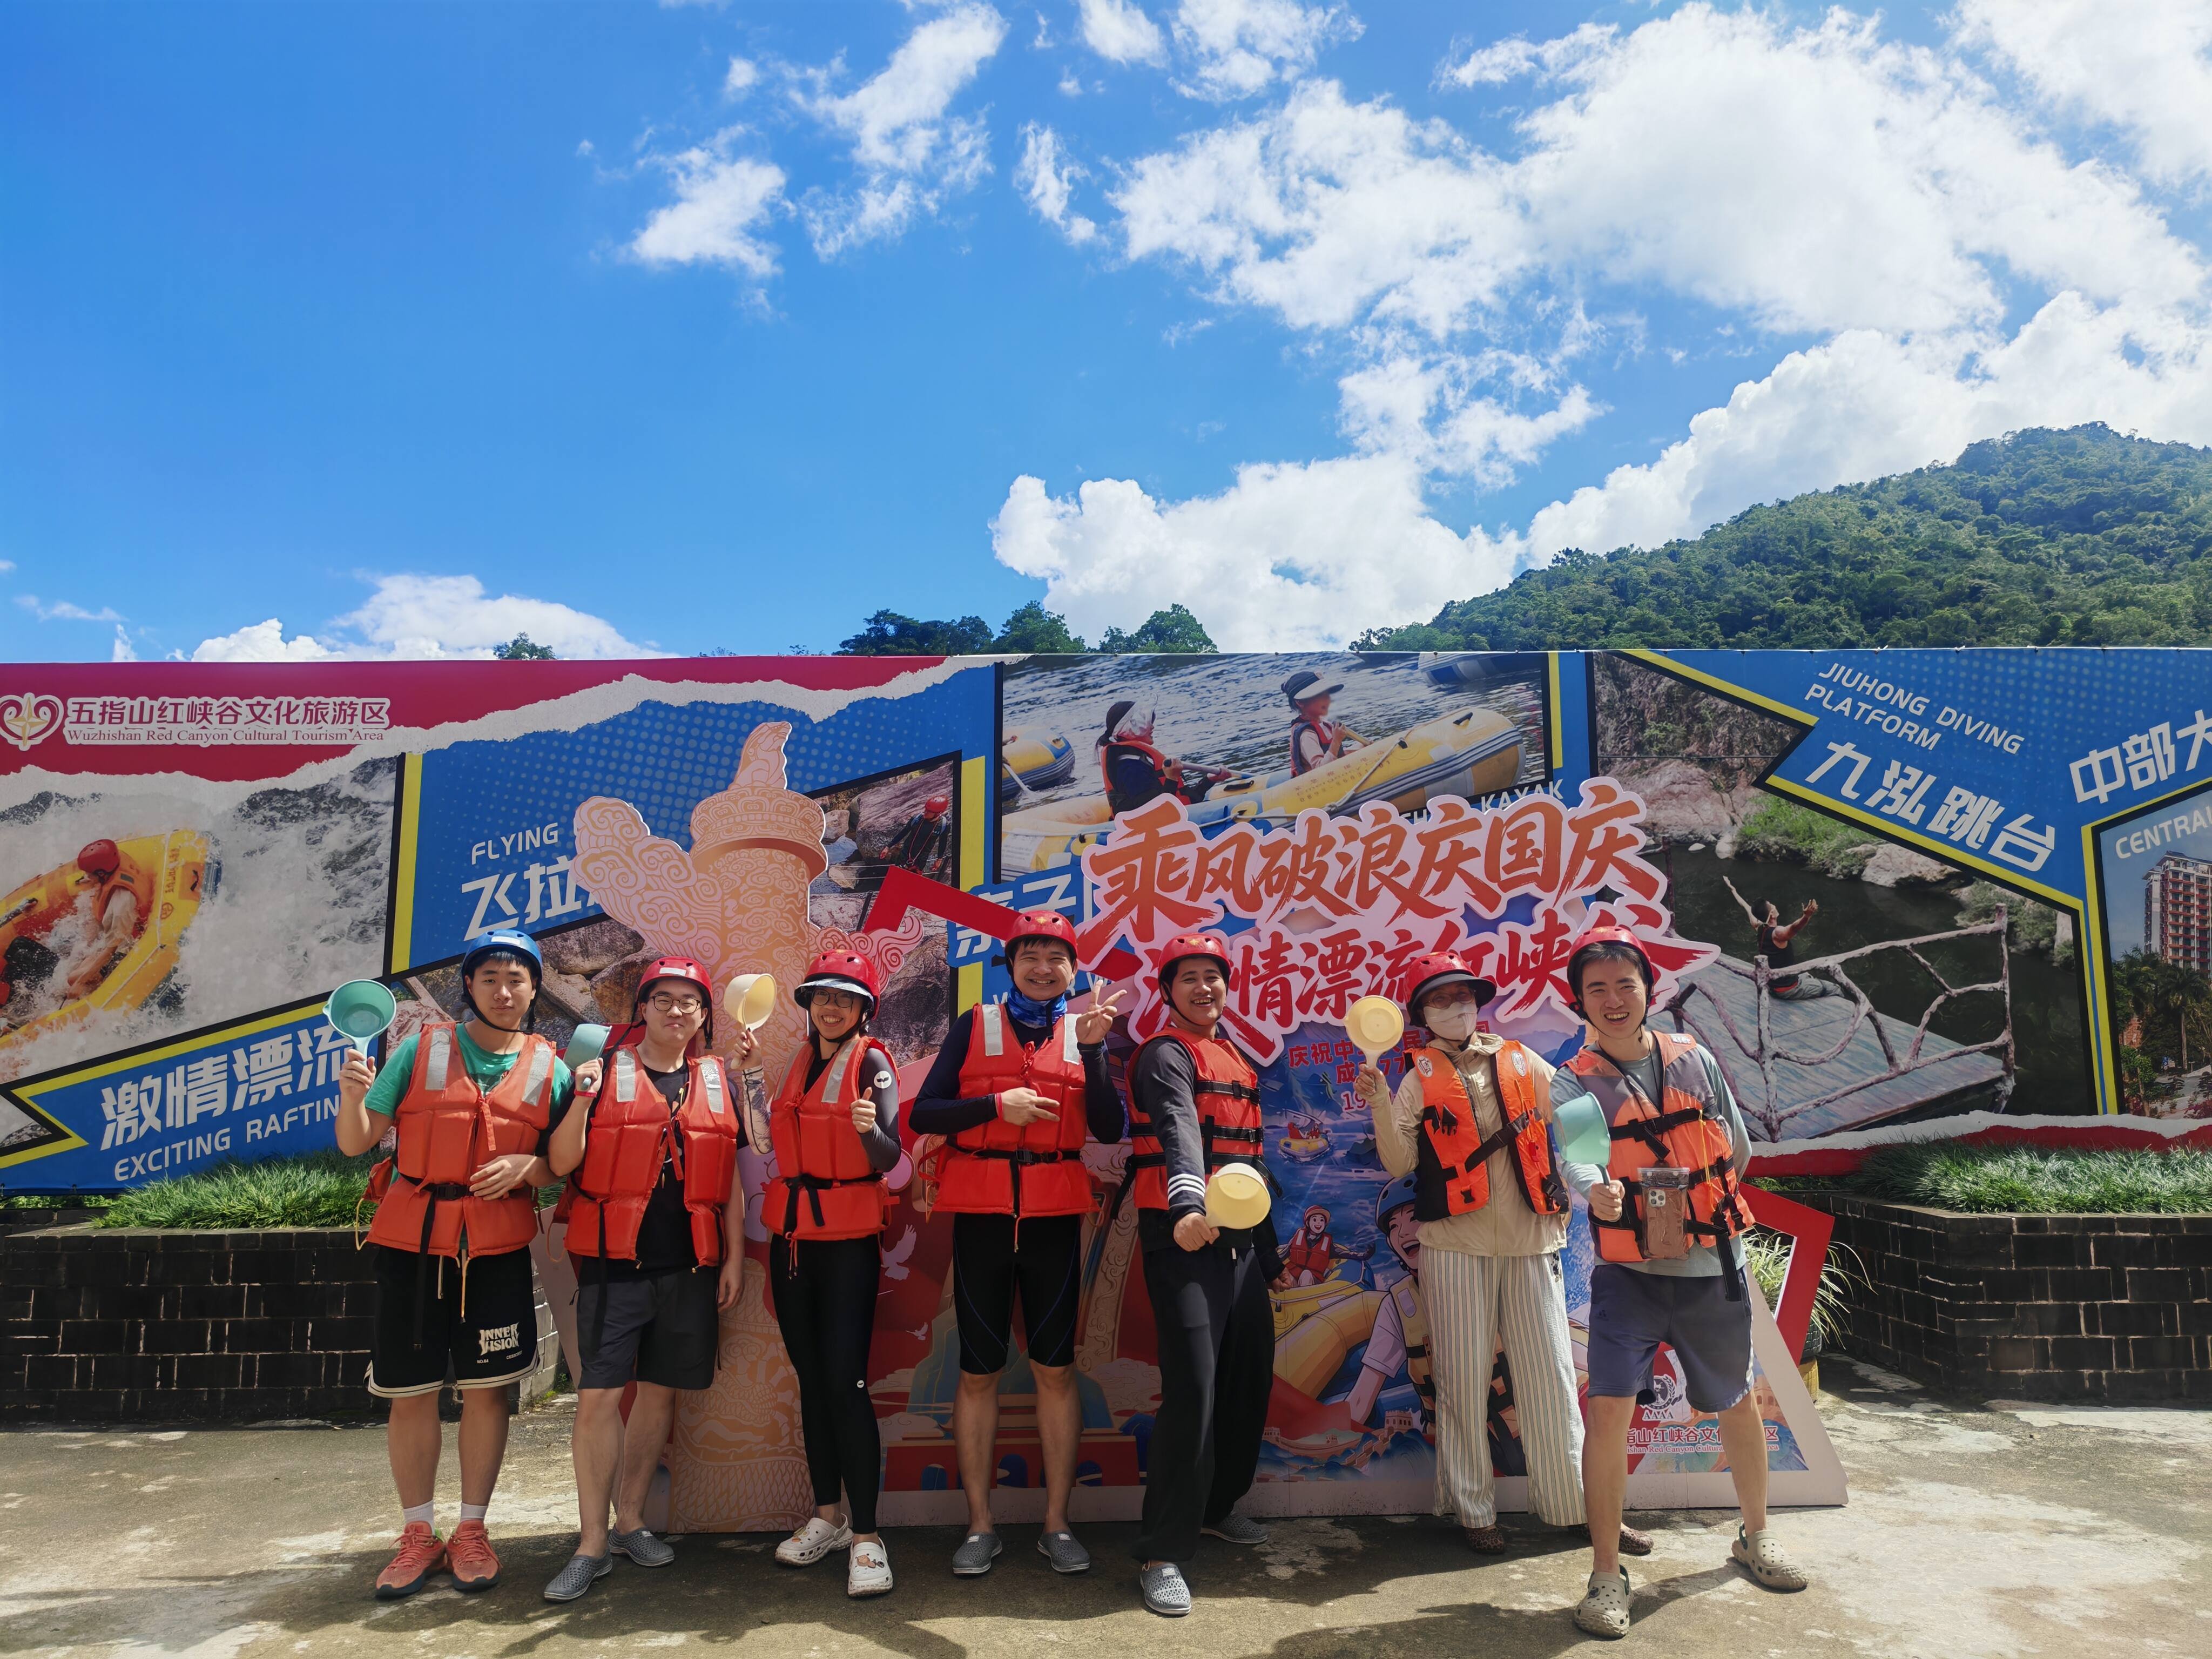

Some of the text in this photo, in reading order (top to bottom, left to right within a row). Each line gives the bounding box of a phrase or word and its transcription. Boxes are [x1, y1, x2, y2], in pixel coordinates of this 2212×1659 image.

[69, 700, 386, 725] 五指山红峡谷文化旅游区
[1804, 683, 1941, 751] PLATFORM
[1818, 663, 2025, 754] JIUHONG DIVING
[68, 730, 384, 744] Wuzhishan Red Canyon Cultural Tourism Area
[1805, 741, 2055, 872] 九泓跳台
[471, 822, 558, 865] FLYING
[461, 855, 596, 941] 飞拉
[1078, 785, 1660, 965] 乘风破浪庆国庆
[114, 1094, 340, 1182] EXCITING RAFTIN
[478, 1336, 520, 1356] VISION
[479, 1322, 520, 1341] INNER
[1665, 1445, 1694, 1455] Canyon
